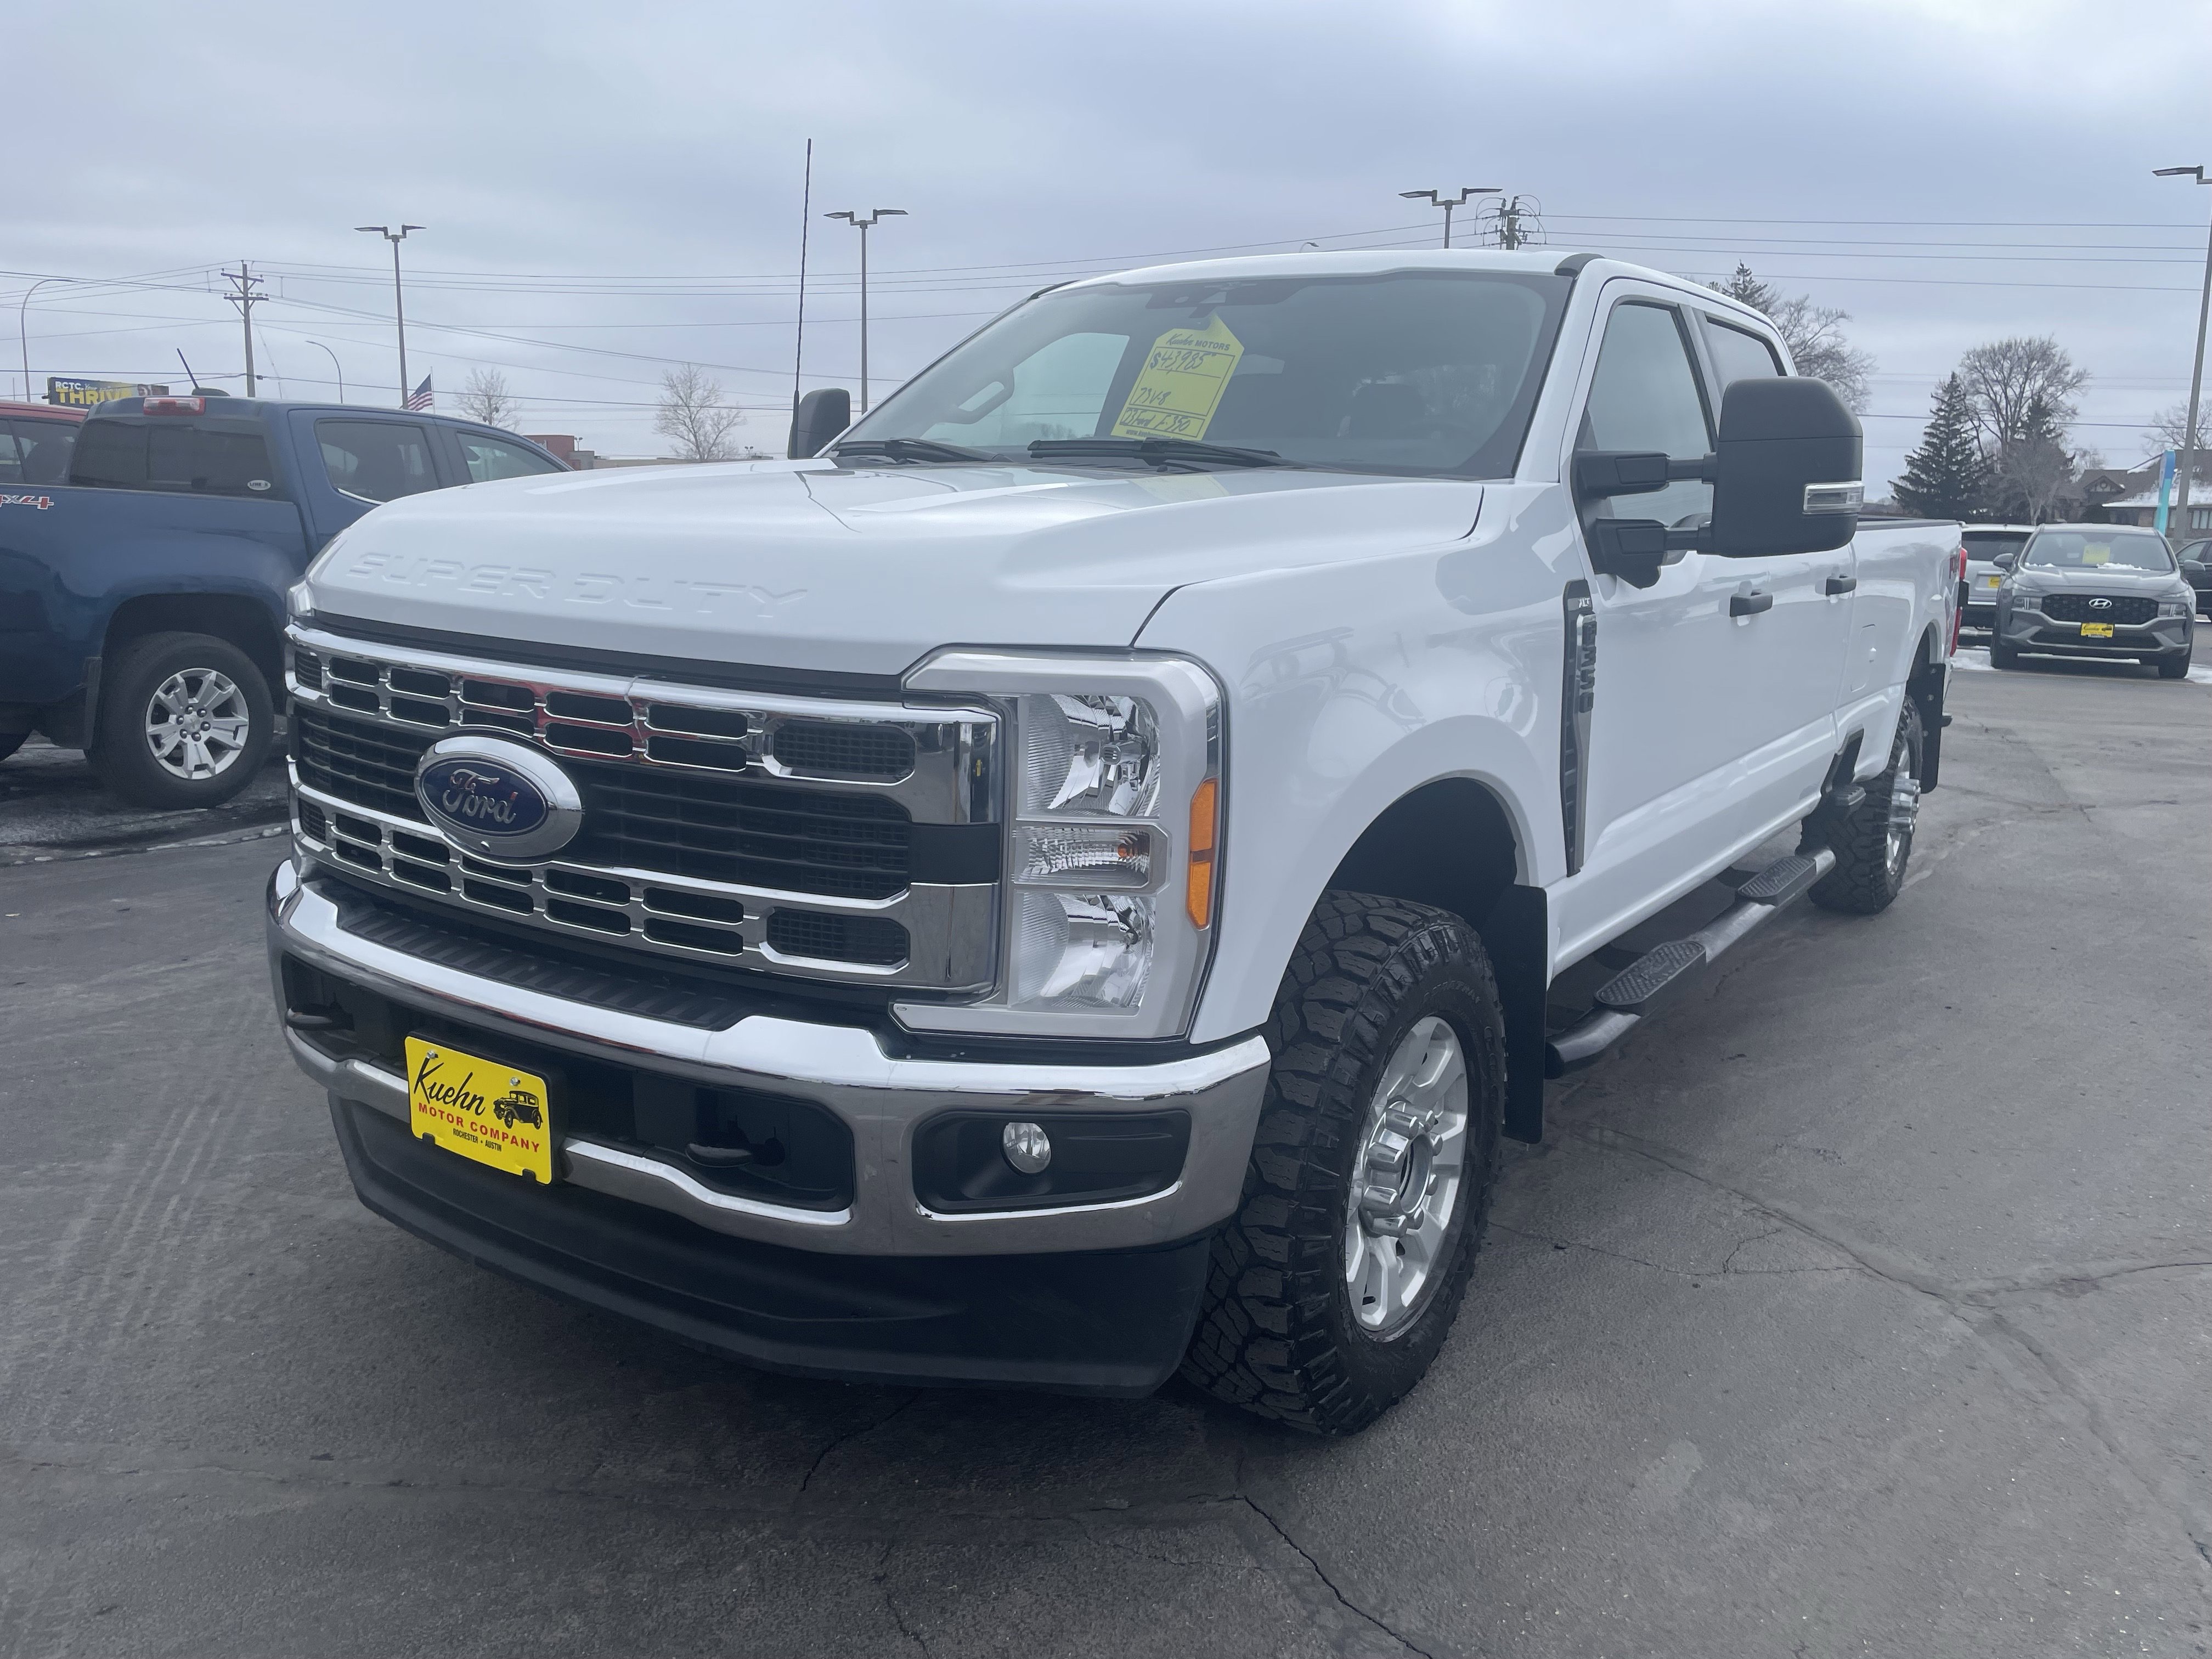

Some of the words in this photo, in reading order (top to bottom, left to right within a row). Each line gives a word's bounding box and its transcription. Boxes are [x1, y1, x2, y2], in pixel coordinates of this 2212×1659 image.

[1195, 340, 1230, 351] MOTORS
[346, 551, 556, 599] SUPER
[564, 572, 808, 618] DUTY
[442, 769, 518, 823] Ford
[414, 1057, 486, 1116] Kuehn
[419, 1102, 464, 1127] MOTOR
[470, 1121, 540, 1153] COMPANY
[453, 1128, 478, 1143] ROCHESTER
[485, 1139, 501, 1152] AUSTIN
